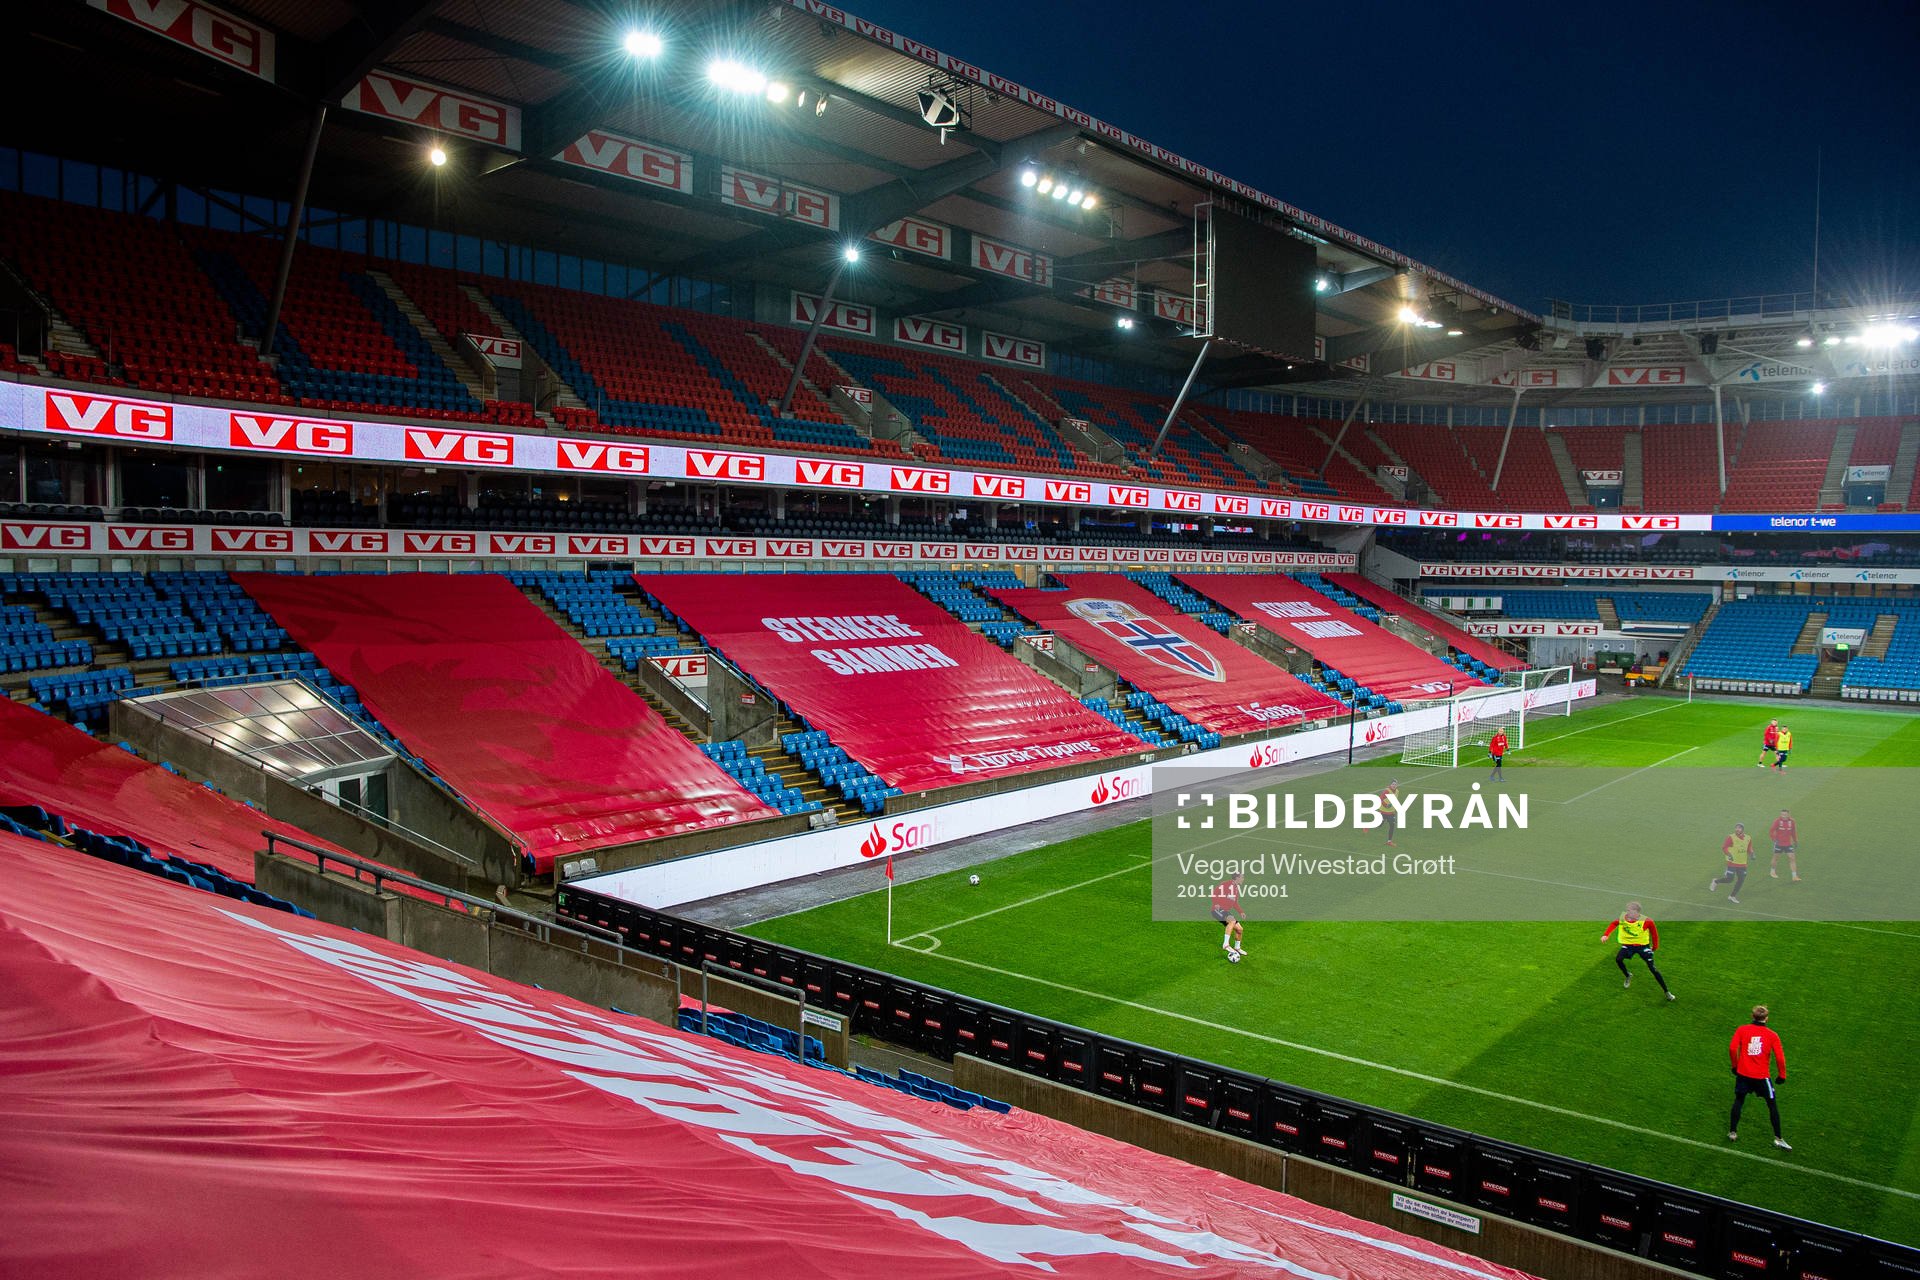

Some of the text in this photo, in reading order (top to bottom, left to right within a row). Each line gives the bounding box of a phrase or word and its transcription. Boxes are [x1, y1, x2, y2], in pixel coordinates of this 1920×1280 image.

[807, 0, 843, 30] VG
[857, 19, 892, 46] VG
[904, 40, 937, 64] VG
[948, 58, 980, 79] VG
[989, 74, 1018, 96] VG
[1028, 90, 1055, 111] VG
[1064, 104, 1090, 126] VG
[1097, 120, 1121, 139] VG
[1129, 134, 1151, 153] VG
[1158, 148, 1180, 164] VG
[1187, 161, 1207, 178] VG
[1213, 173, 1232, 188] VG
[365, 76, 498, 139] VG
[575, 134, 674, 185] VG
[740, 180, 824, 222] VG
[800, 297, 1041, 365] VG VG VG
[1611, 368, 1682, 384] VG
[49, 394, 1677, 528] VG VG VG VG VG VG VG VG VG VG VG VG VG VG VG VG VG VG VG VG
[1586, 472, 1619, 480] VG
[1771, 516, 1837, 527] telenor t-we
[6, 526, 85, 549] VG
[112, 528, 189, 549] VG
[215, 530, 289, 550] VG
[312, 532, 384, 551] VG
[407, 535, 471, 552] VG
[493, 536, 553, 553] VG
[571, 537, 625, 553] VG
[643, 539, 692, 554] VG
[707, 540, 753, 554] VG
[768, 541, 811, 556] VG
[822, 543, 862, 557] VG
[875, 544, 911, 558] VG
[922, 545, 956, 558] VG
[965, 546, 999, 559] VG
[1006, 547, 1036, 559] VG
[1044, 548, 1073, 559] VG
[1081, 550, 1107, 561] VG
[1114, 550, 1138, 561] VG
[1144, 551, 1168, 562] VG
[1174, 551, 1196, 562] VG
[1202, 552, 1223, 563] VG
[1228, 552, 1248, 563] VG
[1423, 565, 1691, 577] VG VG VG VG VG VG VG
[1738, 569, 1898, 579] telenor telenor telenor
[1510, 624, 1543, 634] VG
[1559, 626, 1596, 634] VG
[810, 643, 959, 676] SAMMEN
[1276, 1122, 1297, 1133] LIVECOM
[1323, 1137, 1346, 1147] LIVECOM
[1374, 1150, 1397, 1161] LIVECOM
[1425, 1165, 1450, 1177] LIVECOM
[1483, 1181, 1508, 1193] LIVECOM
[1539, 1199, 1566, 1211] LIVECOM
[1601, 1215, 1630, 1228] LIVECOM
[1664, 1233, 1693, 1246] LIVECOM
[1733, 1252, 1764, 1265] LIVECOM
